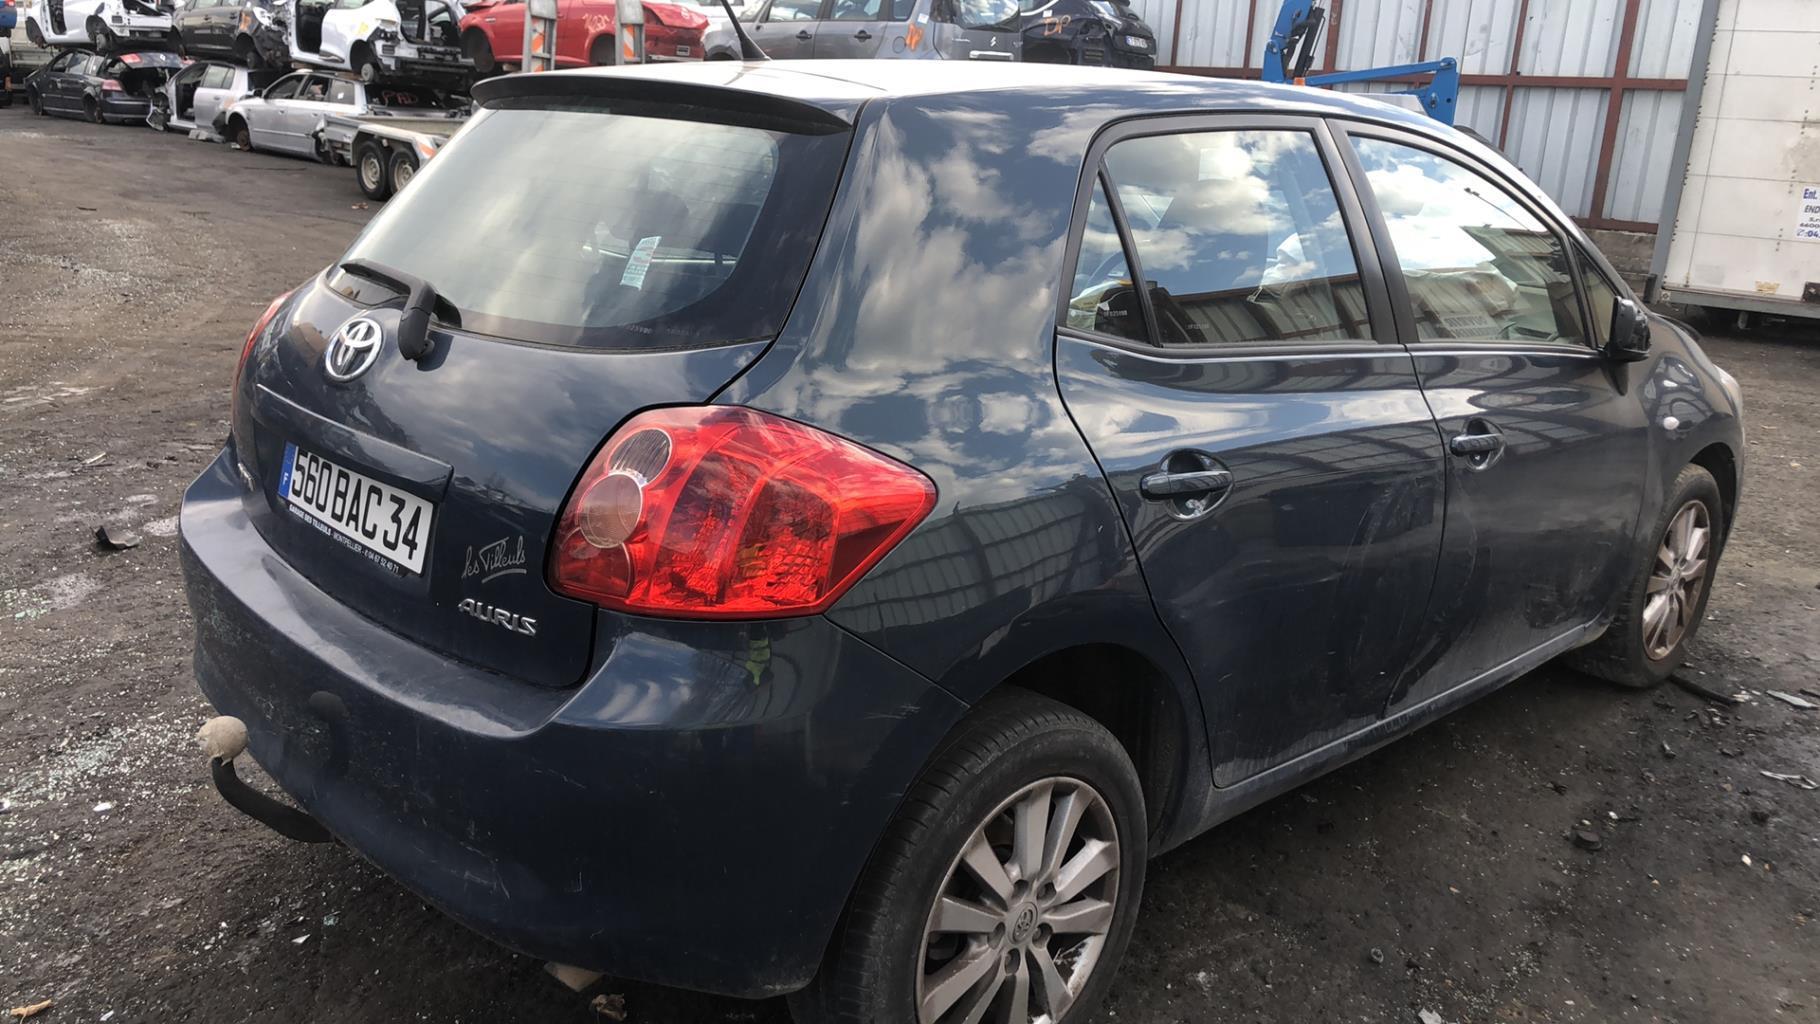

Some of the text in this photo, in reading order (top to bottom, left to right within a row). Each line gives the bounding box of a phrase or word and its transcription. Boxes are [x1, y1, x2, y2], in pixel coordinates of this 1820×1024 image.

[292, 451, 422, 560] 560 BAC 34
[333, 531, 362, 552] MONTPELLIER
[458, 598, 536, 636] AURIS
